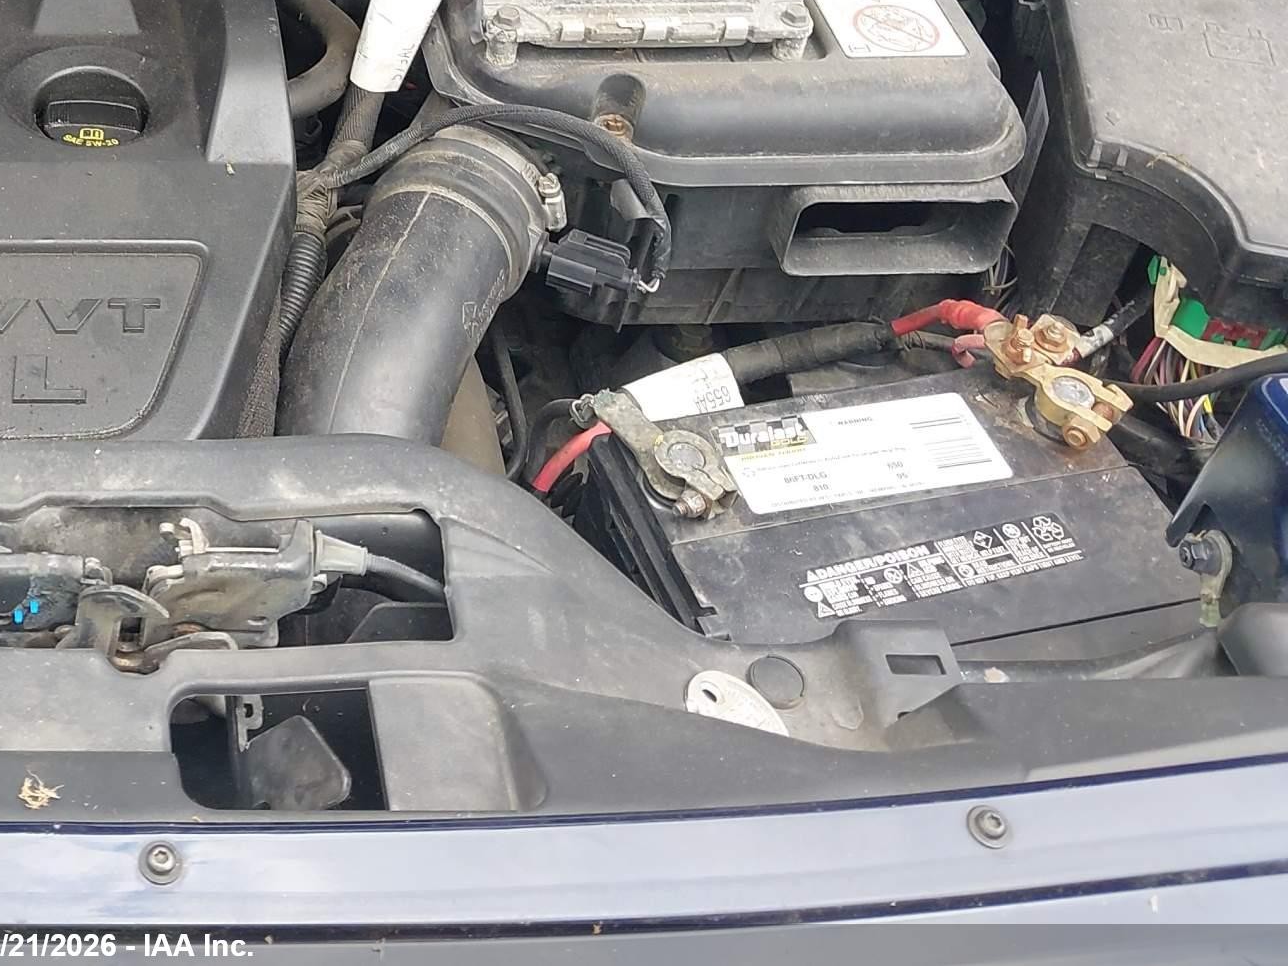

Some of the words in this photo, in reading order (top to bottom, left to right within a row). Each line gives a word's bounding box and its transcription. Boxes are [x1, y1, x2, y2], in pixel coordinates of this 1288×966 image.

[63, 134, 83, 145] SAE
[722, 421, 808, 447] Duralast
[815, 545, 930, 578] DANGER/POISON
